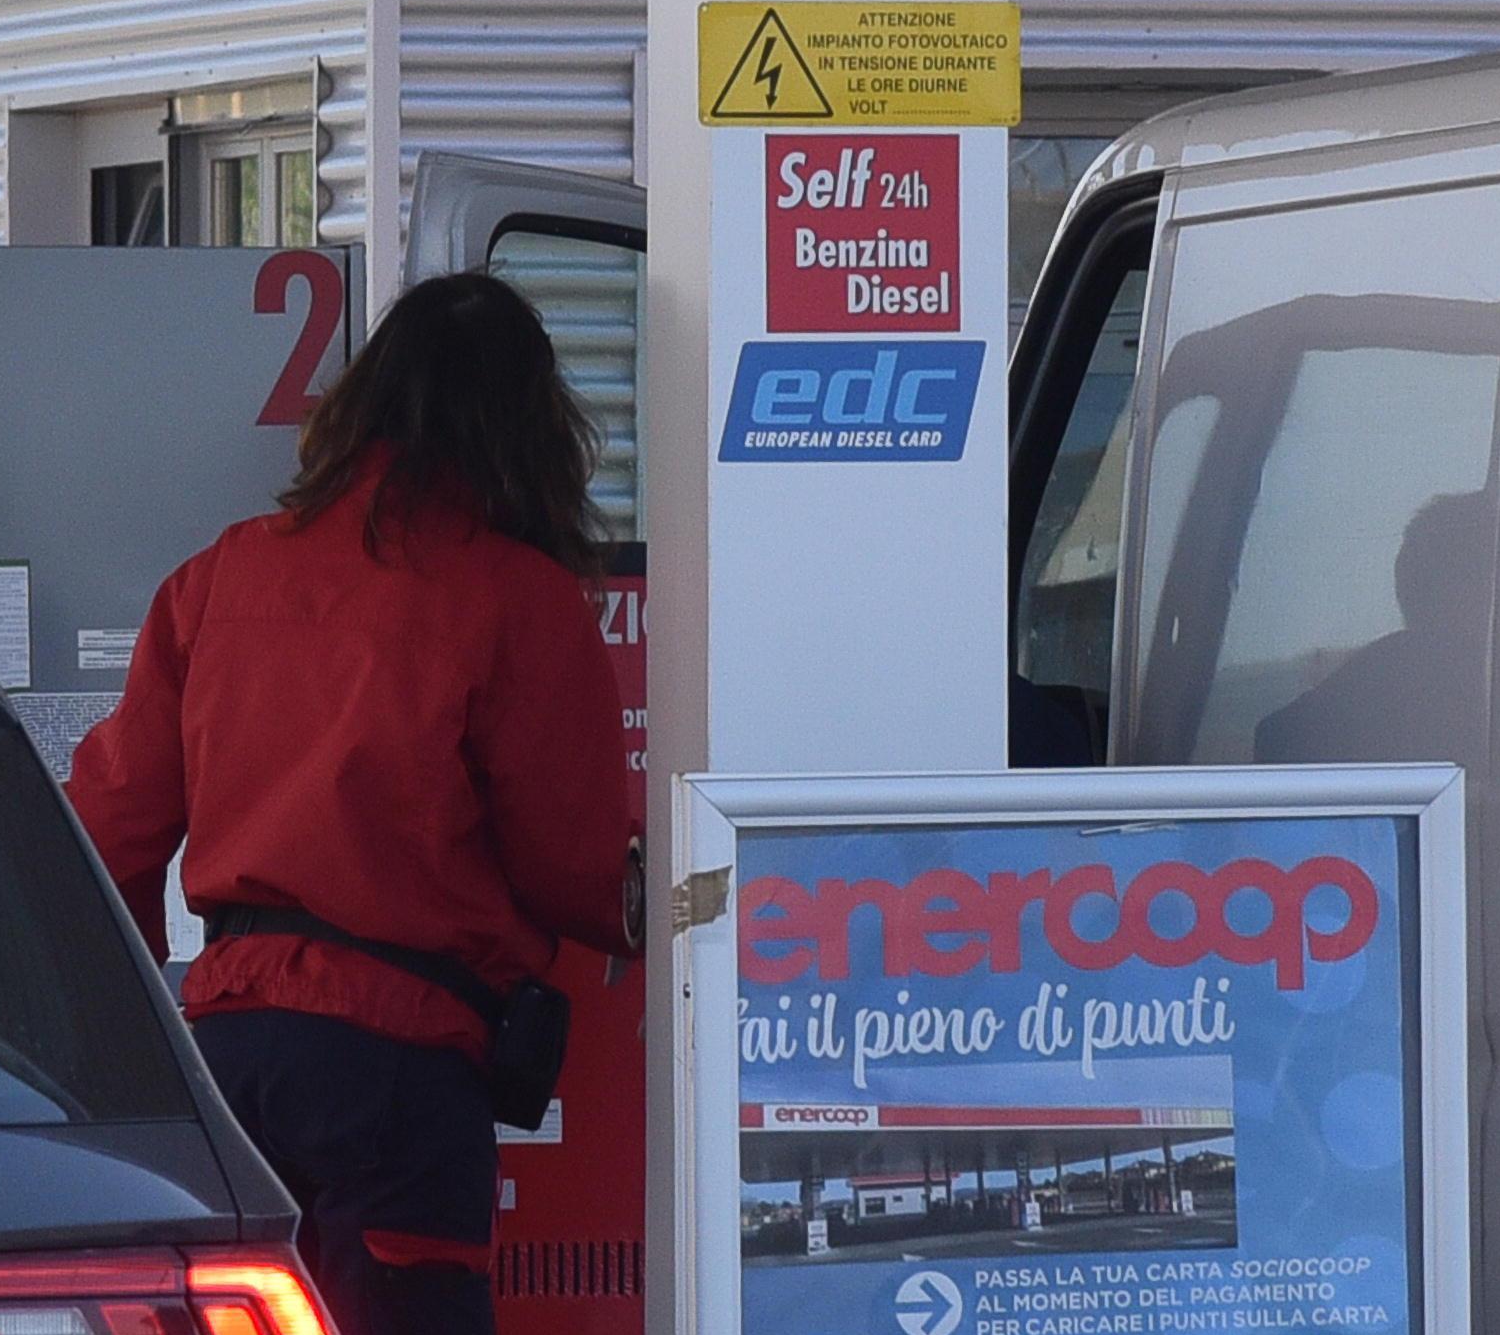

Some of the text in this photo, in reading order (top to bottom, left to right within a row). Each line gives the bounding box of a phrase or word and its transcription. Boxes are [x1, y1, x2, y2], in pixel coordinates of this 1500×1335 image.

[858, 11, 956, 27] ATTENZIONE
[807, 33, 1008, 50] IMPIANTO FOTOVOLTAICO
[818, 55, 996, 71] IN TENSIONE DURANTE
[848, 77, 968, 93] LE ORE DIURNE
[850, 99, 887, 115] VOLT
[777, 148, 928, 210] Self 24h
[795, 228, 929, 268] Benzina
[847, 272, 949, 314] Diesel
[254, 249, 344, 426] 2
[751, 350, 957, 425] edc
[745, 430, 942, 449] EUROPEAN DIESEL CARD
[738, 855, 1378, 990] enercoop
[808, 993, 845, 1059] il
[853, 990, 1005, 1089] pieno
[1019, 982, 1072, 1055] di
[1082, 977, 1236, 1080] punti
[775, 1106, 869, 1126] enercoop
[976, 1257, 1371, 1289] PASSA LA TUA CARTA SOCIOCOOP
[976, 1283, 1335, 1314] AL MOMENTO DEL PAGAMENTO
[1026, 1313, 1144, 1335] CARICARE
[1149, 1313, 1154, 1332] I
[1160, 1311, 1227, 1331] PUNTI
[1233, 1308, 1305, 1329] SULLA
[1312, 1305, 1388, 1325] CARTA
